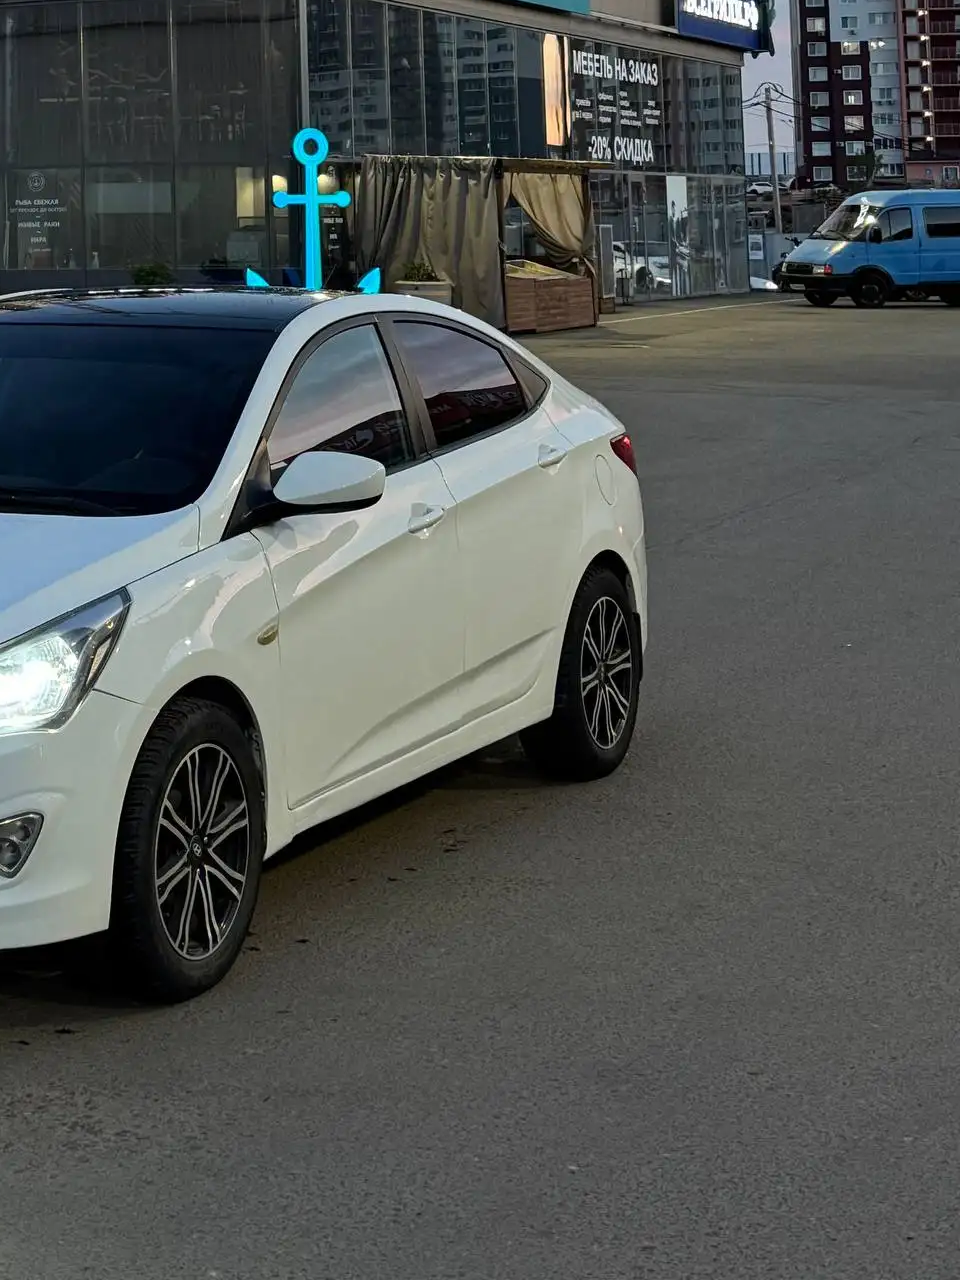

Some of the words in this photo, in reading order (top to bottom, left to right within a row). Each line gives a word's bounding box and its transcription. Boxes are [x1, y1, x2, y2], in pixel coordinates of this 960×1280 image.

[572, 49, 613, 79] МЕБЕЛЬ
[614, 56, 628, 82] НА
[628, 59, 658, 86] ЗАКАЗ
[588, 135, 612, 160] -20%
[613, 135, 654, 166] СКИДКА
